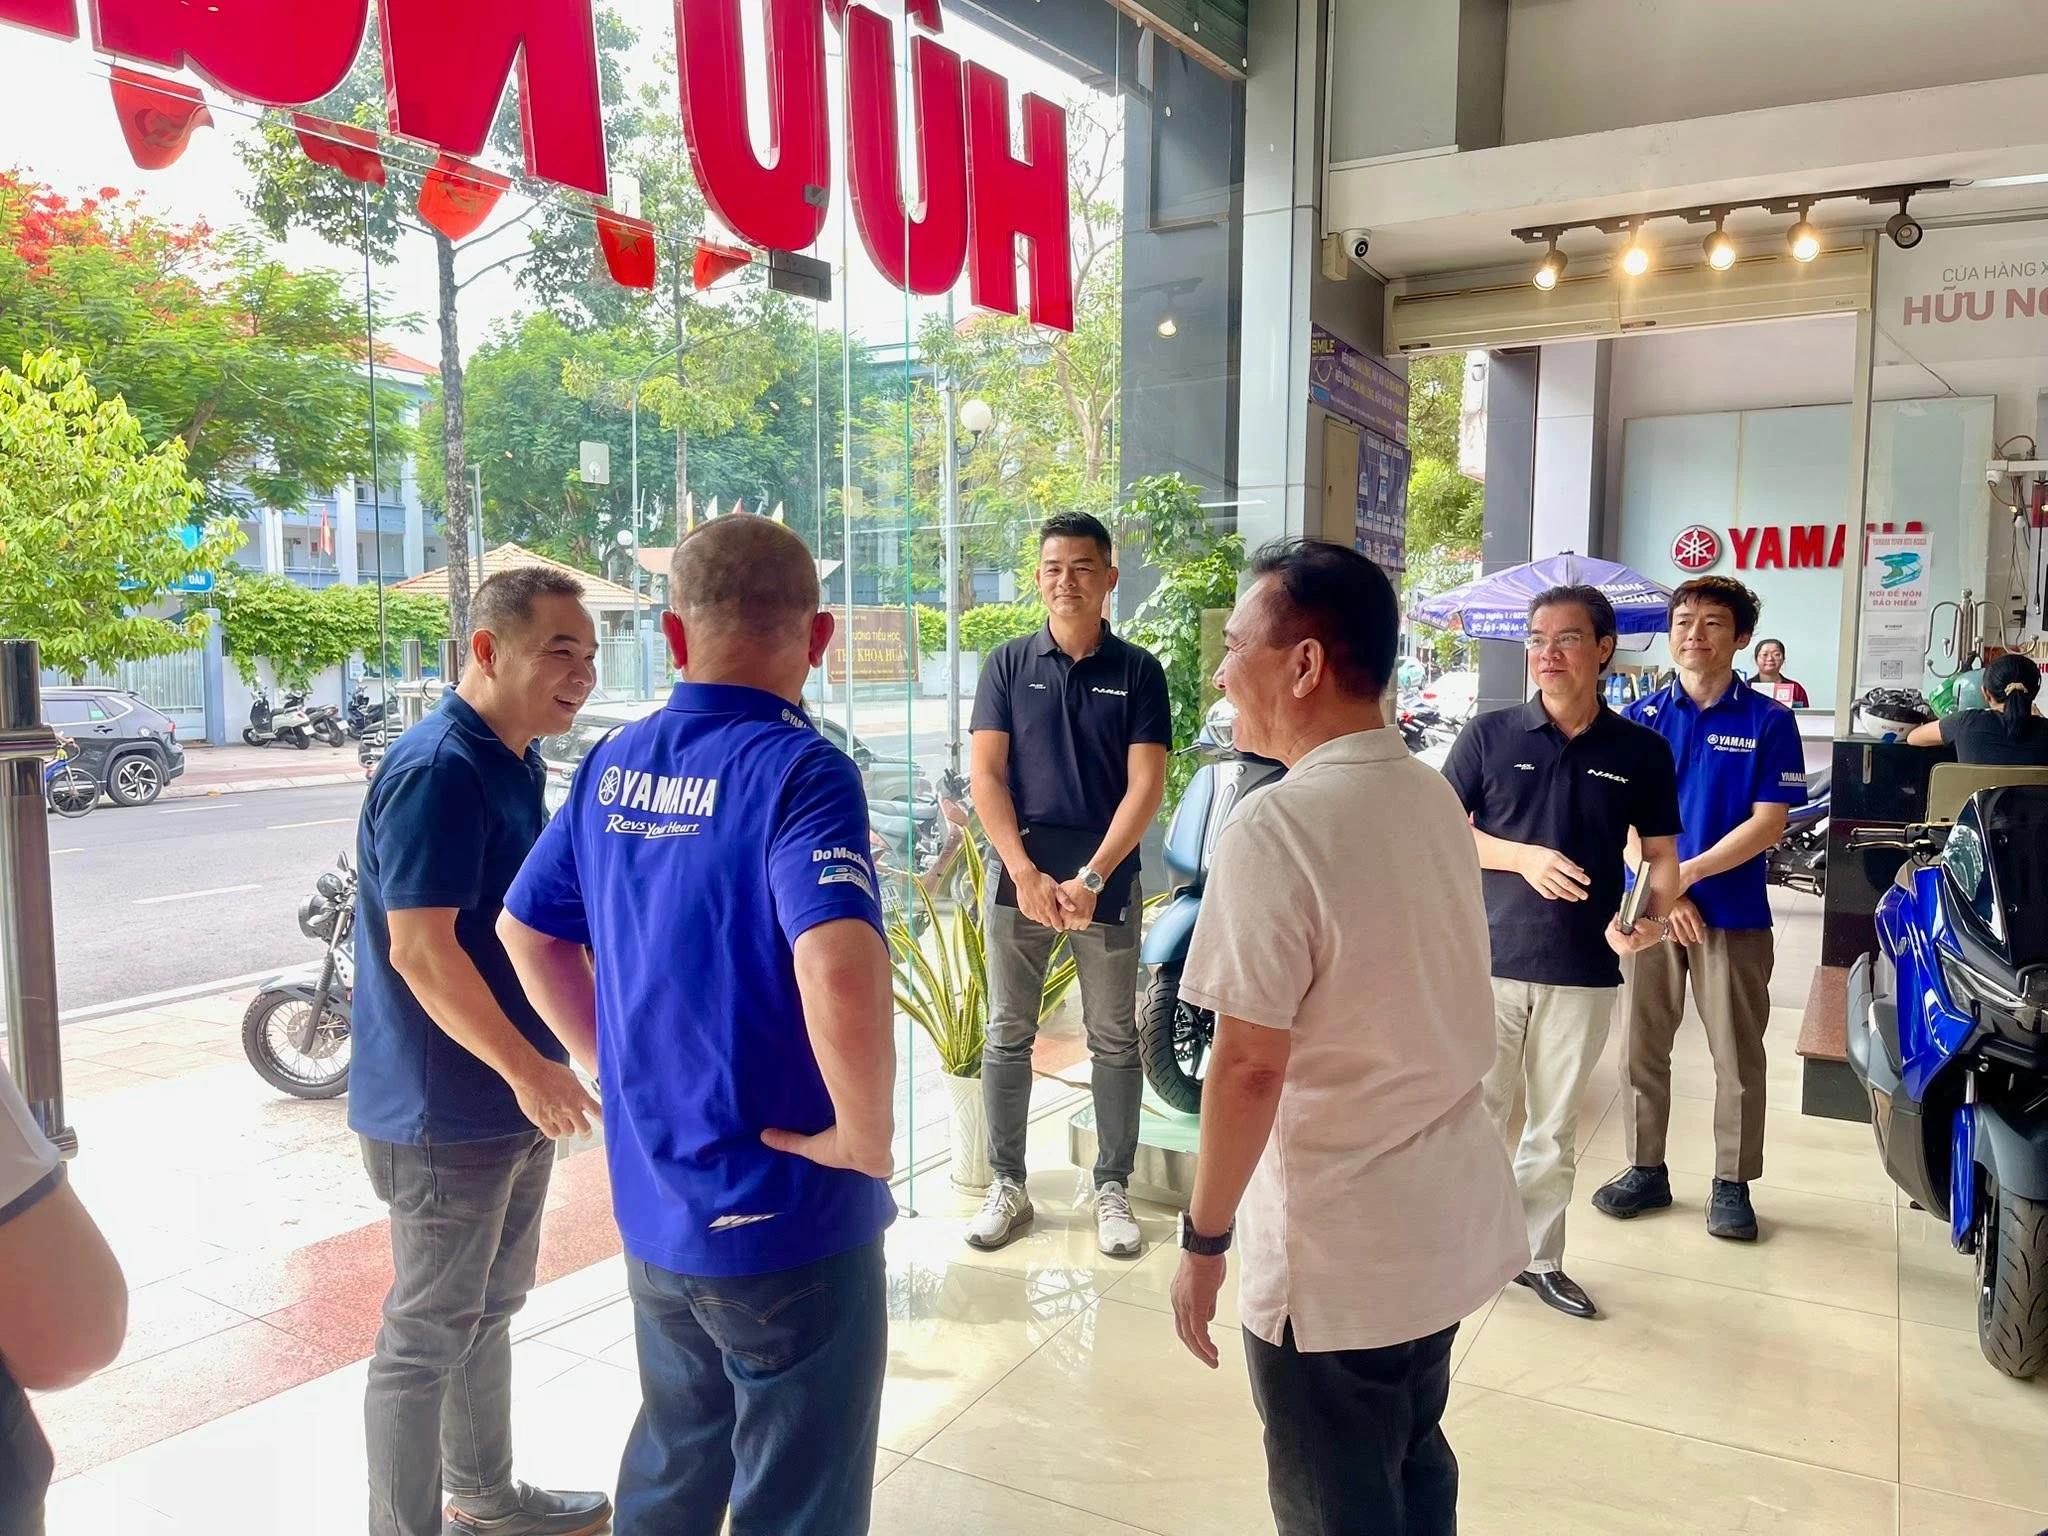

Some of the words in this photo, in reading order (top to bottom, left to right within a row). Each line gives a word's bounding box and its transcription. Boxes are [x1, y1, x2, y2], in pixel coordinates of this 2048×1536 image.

[1984, 261, 2036, 279] HÀNG
[1903, 285, 1995, 325] HỮU
[1311, 340, 1335, 354] SMILE
[1728, 522, 1923, 569] YAMA
[1594, 583, 1646, 593] AMAHA
[857, 648, 884, 662] KHOA
[1720, 735, 1756, 749] YAMAHA
[620, 769, 718, 817] YAMAHA
[605, 814, 646, 833] Revs
[667, 821, 700, 833] Heart
[812, 849, 831, 862] Do
